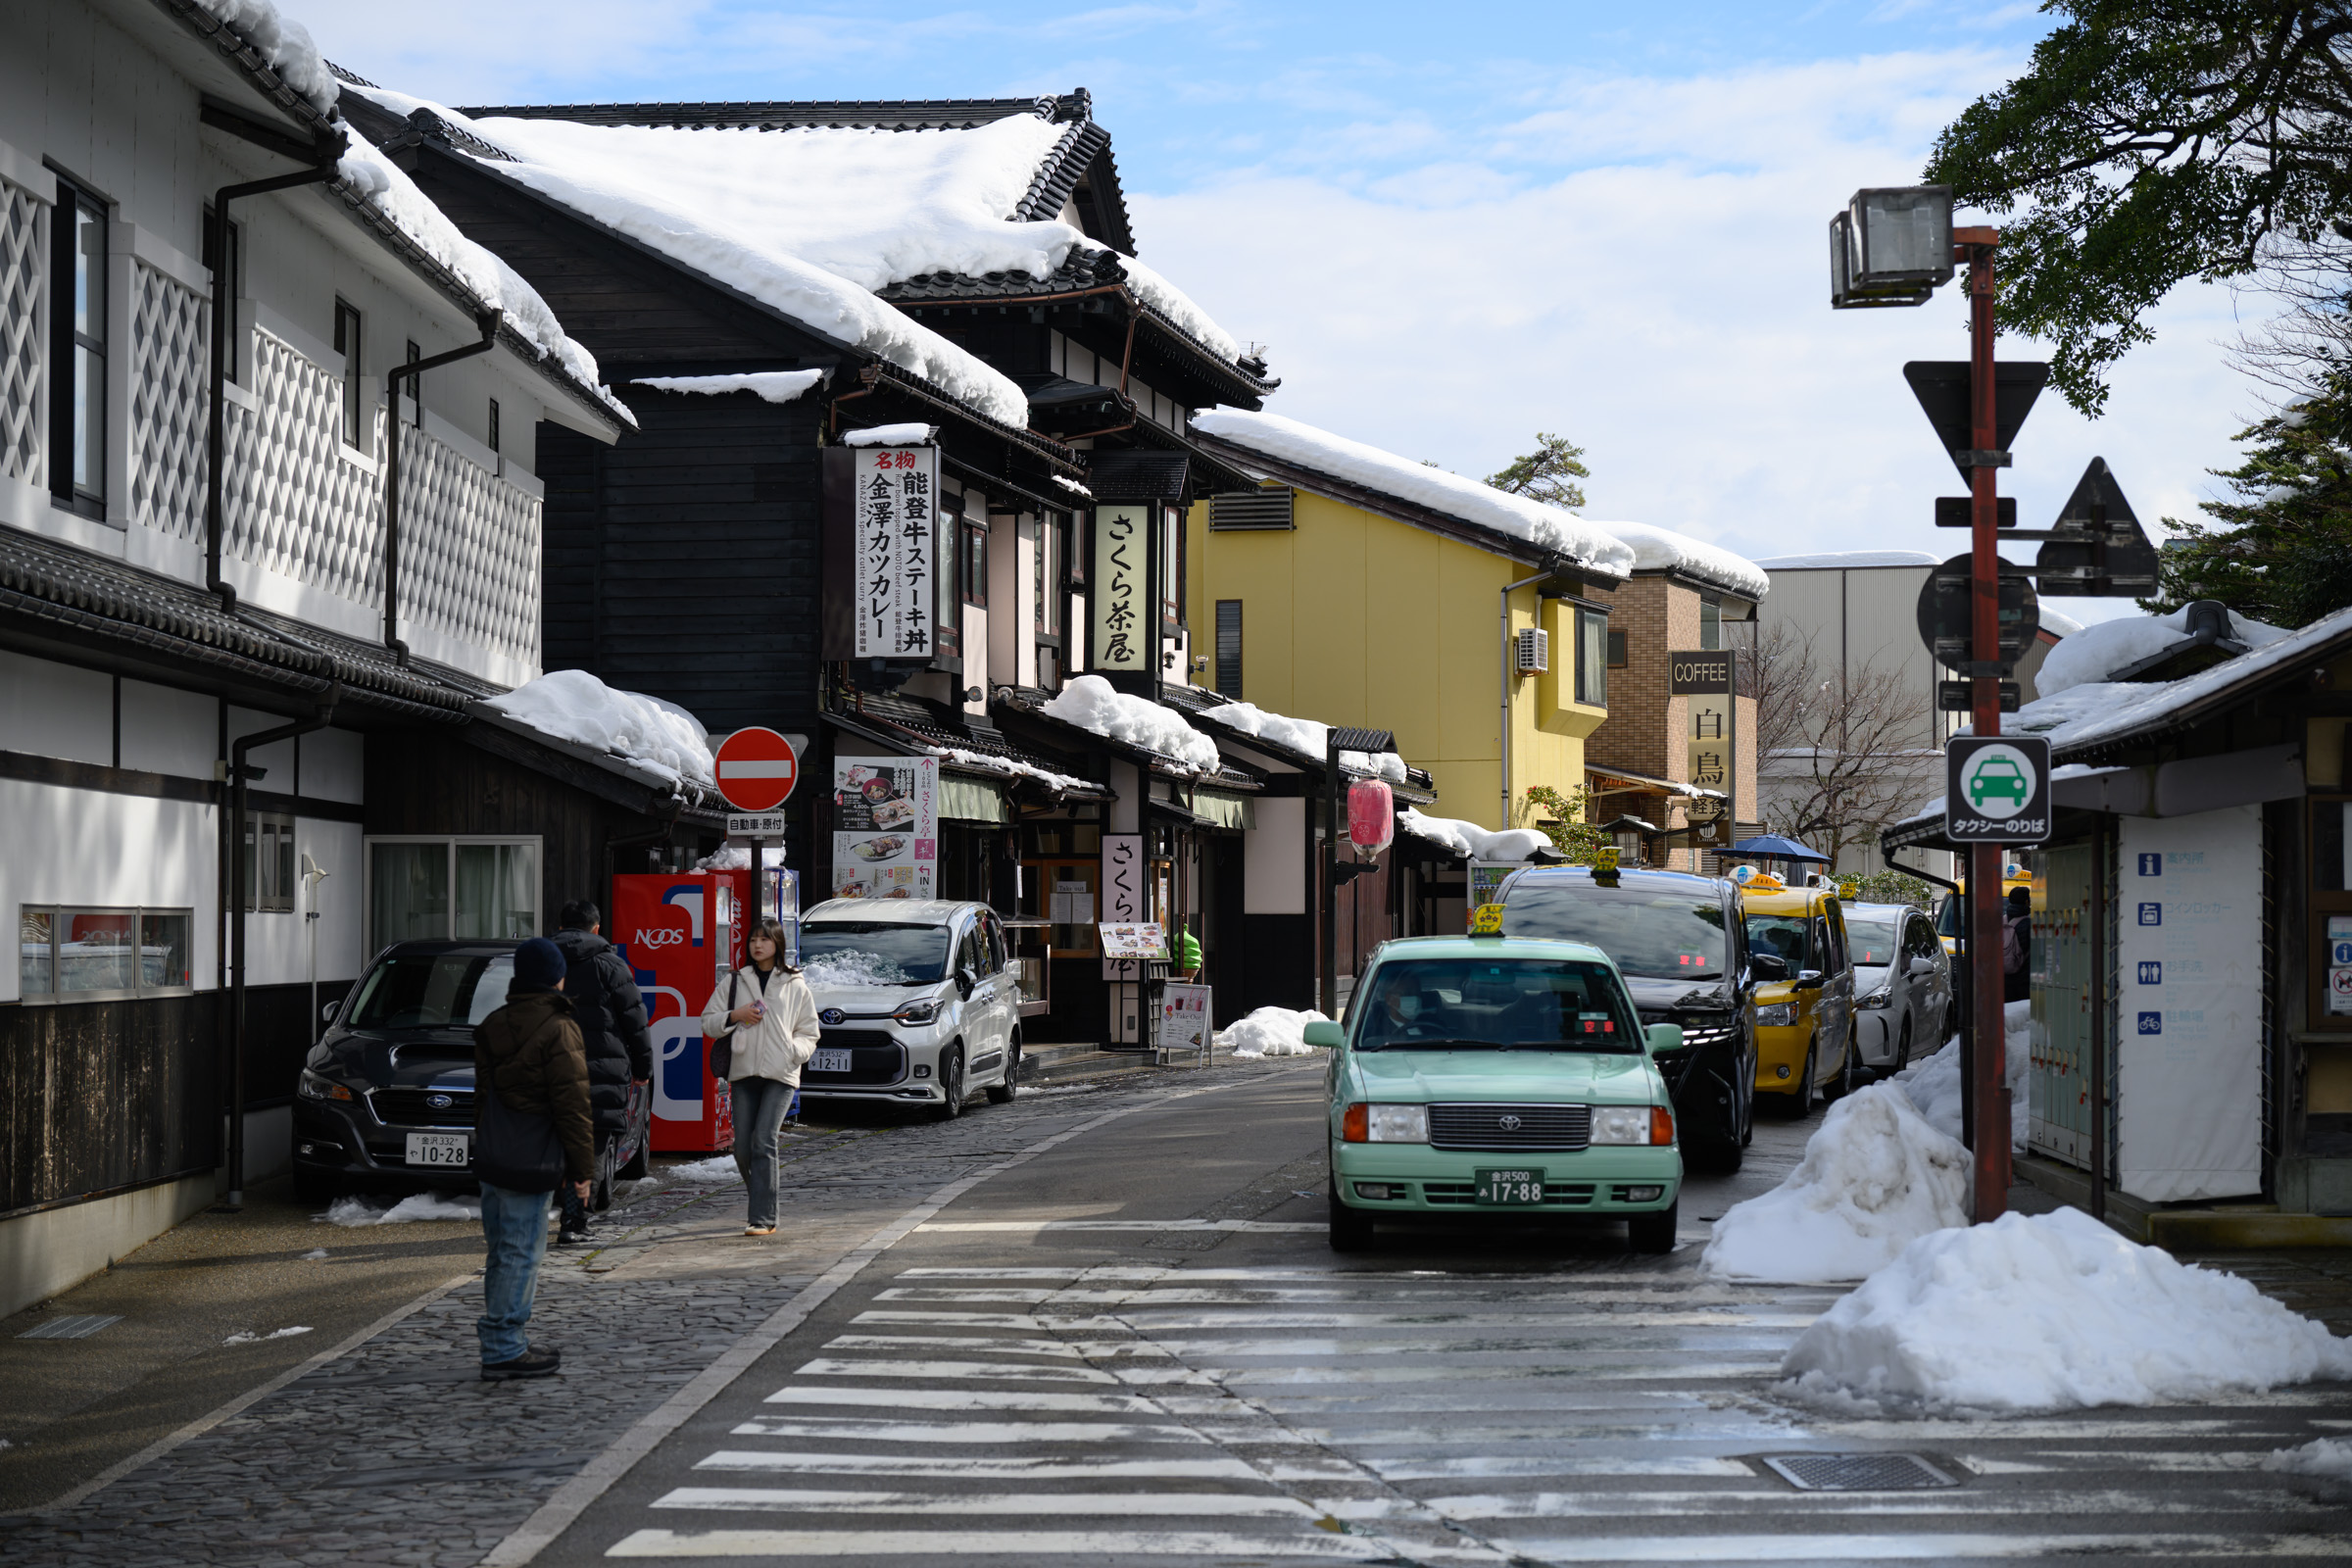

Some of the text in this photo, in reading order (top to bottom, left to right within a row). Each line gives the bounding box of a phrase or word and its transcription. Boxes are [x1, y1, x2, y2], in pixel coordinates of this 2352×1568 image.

[873, 451, 916, 469] 名物
[866, 472, 895, 639] 金澤カツカレー
[903, 471, 929, 654] 能登牛ステーキ丼
[1104, 514, 1136, 662] さくら茶屋
[1674, 663, 1727, 682] COFFEE
[1693, 708, 1725, 784] 白鳥
[730, 817, 782, 831] 自動車・原付
[1954, 818, 2045, 833] タクシーのりば
[919, 876, 929, 885] IN
[2165, 903, 2232, 914] コインロッカー
[819, 1057, 848, 1070] 12-11
[421, 1136, 455, 1146] 金沢332
[421, 1147, 464, 1163] 10-28
[1492, 1171, 1530, 1182] 金沢500
[1479, 1183, 1542, 1201] あ 17-88
